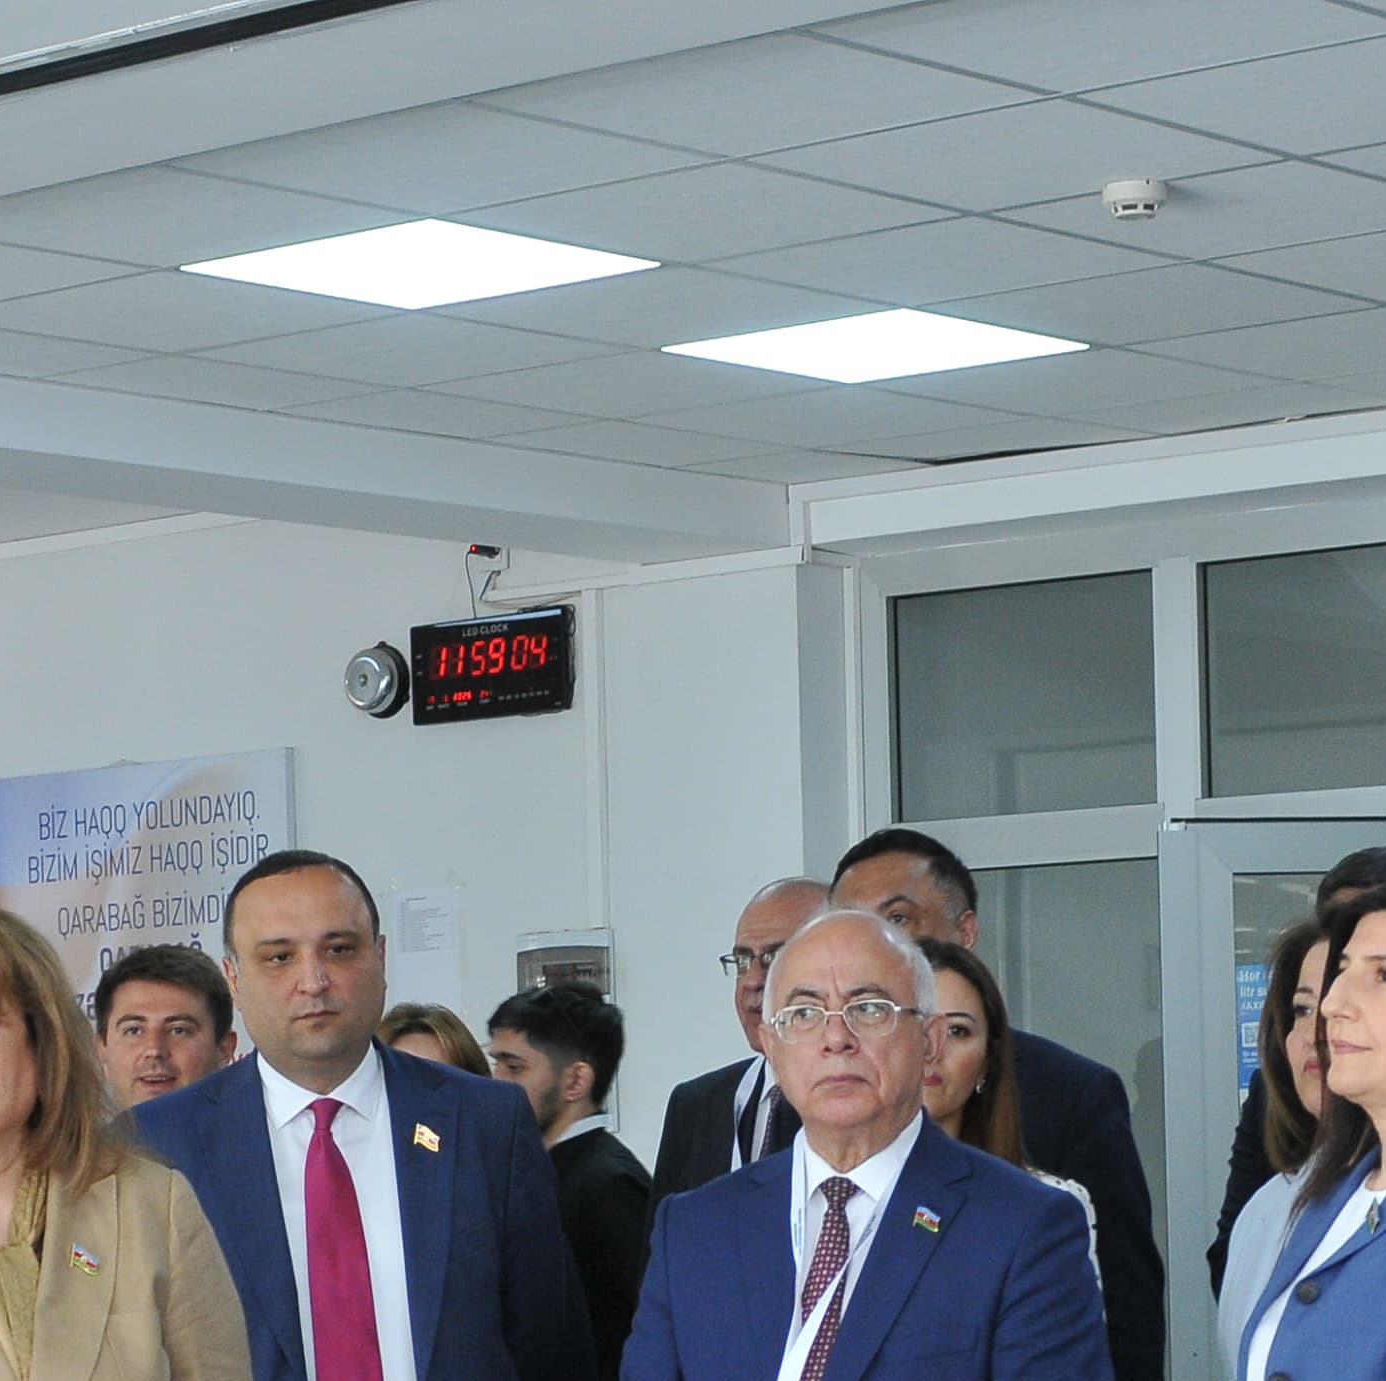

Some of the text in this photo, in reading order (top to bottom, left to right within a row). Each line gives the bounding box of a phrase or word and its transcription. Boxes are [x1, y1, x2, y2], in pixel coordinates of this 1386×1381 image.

[479, 623, 509, 635] CLOCK
[38, 790, 261, 841] BİZ HAQQ YOLUNDAYIQ.
[28, 827, 270, 886] BİZİM İŞİMİZ HAQQ İŞİDİR
[57, 887, 230, 941] QARABAĞ BİZİMDİ
